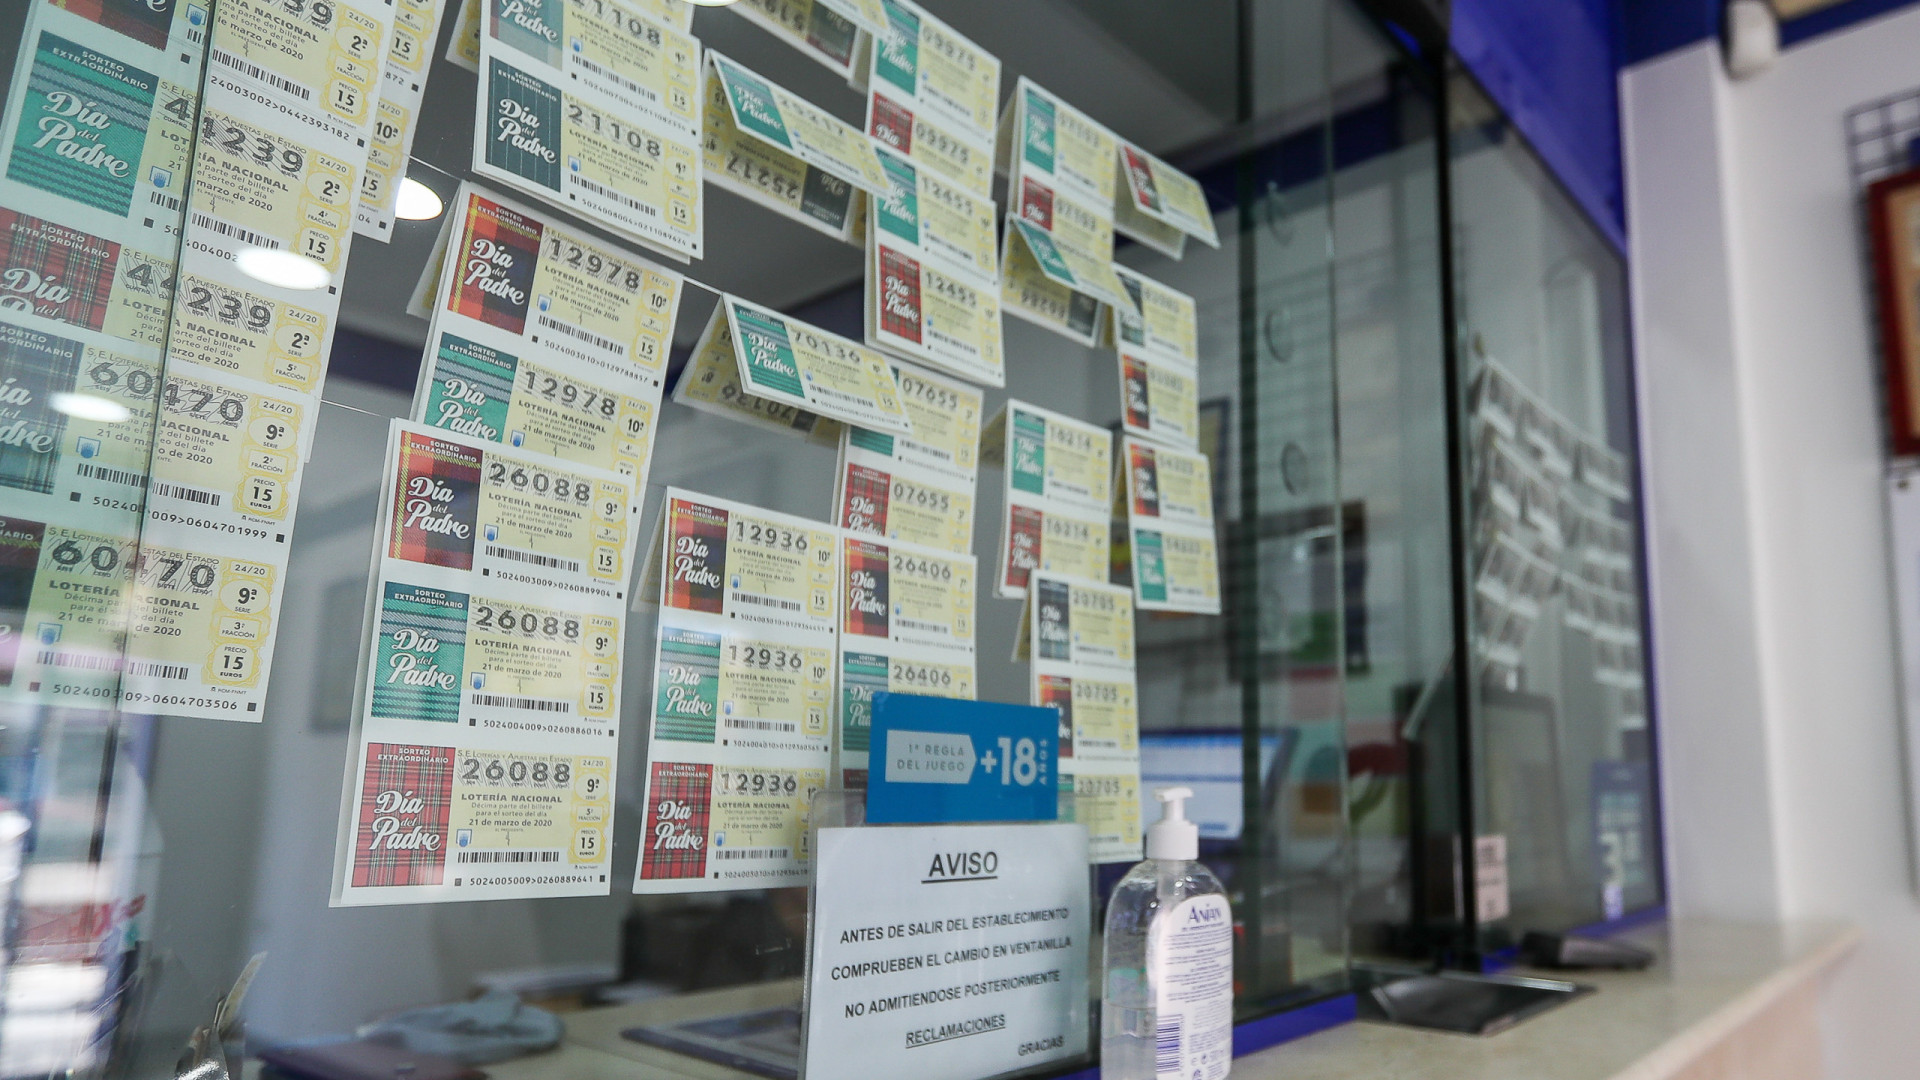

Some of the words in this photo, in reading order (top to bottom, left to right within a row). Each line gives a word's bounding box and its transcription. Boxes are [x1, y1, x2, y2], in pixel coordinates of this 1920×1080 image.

[254, 7, 319, 43] NACIONAL
[348, 11, 375, 30] 24/20
[280, 44, 304, 61] 2020
[394, 37, 411, 53] 15
[52, 47, 148, 90] EXTRAORDINARIO
[82, 50, 125, 72] SORTEO
[336, 89, 355, 106] 15
[42, 91, 110, 130] Día
[498, 98, 540, 128] Día
[76, 128, 100, 142] del
[521, 127, 536, 137] del
[568, 103, 661, 157] 21108
[33, 116, 130, 178] Padre
[497, 117, 557, 163] Padre
[319, 156, 348, 173] 24/20
[221, 160, 289, 192] NACIONAL
[248, 197, 273, 212] 2020
[495, 206, 523, 222] SORTEO
[306, 215, 337, 230] FRACCIÓN
[477, 205, 538, 235] EXTRAORDINARIO
[10, 223, 110, 259] EXTRAORDINARIO
[40, 224, 85, 243] SORTEO
[308, 229, 331, 242] PRECIO
[307, 237, 326, 255] 15
[471, 238, 514, 268] Día
[305, 251, 326, 263] EUROS
[550, 237, 642, 291] 12978
[464, 259, 525, 305] Padre
[492, 268, 506, 279] del
[1, 268, 71, 304] Día
[544, 265, 585, 289] LOTERÍA
[586, 282, 631, 305] NACIONAL
[36, 304, 59, 318] del
[289, 309, 317, 323] 24/20
[186, 322, 256, 348] NACIONAL
[449, 344, 512, 370] EXTRAORDINARIO
[468, 343, 497, 358] SORTEO
[640, 341, 653, 355] 15
[214, 355, 240, 370] 2020
[275, 368, 306, 382] FRACCIÓN
[442, 378, 486, 406] Día
[525, 371, 617, 417] 12978
[262, 399, 293, 414] 24/20
[464, 405, 479, 416] del
[518, 399, 559, 418] LOTERÍA
[561, 410, 606, 433] NACIONAL
[435, 400, 497, 441] Padre
[410, 441, 477, 463] EXTRAORDINARIO
[430, 440, 460, 452] SORTEO
[186, 452, 213, 465] 2020
[250, 461, 283, 474] FRACCIÓN
[253, 477, 276, 487] PRECIO
[408, 476, 455, 503] Día
[488, 462, 592, 502] 26088
[253, 486, 272, 501] 15
[893, 482, 950, 511] 07655
[250, 502, 272, 510] EUROS
[432, 502, 448, 514] del
[488, 492, 531, 509] LOTERÍA
[535, 500, 582, 520] NACIONAL
[404, 499, 470, 539] Padre
[554, 527, 573, 538] 2020
[735, 521, 808, 551] 12936
[676, 536, 709, 557] Día
[234, 564, 266, 576] 24/20
[598, 554, 612, 567] 15
[693, 558, 705, 567] del
[893, 555, 951, 580] 26406
[674, 555, 721, 589] Padre
[49, 580, 121, 597] LOTERÍA
[414, 589, 446, 599] SORTEO
[234, 606, 251, 614] SERIE
[394, 593, 463, 609] EXTRAORDINARIO
[153, 625, 182, 637] 2020
[475, 606, 580, 638] 26088
[221, 629, 255, 639] FRACCIÓN
[392, 629, 440, 653] Día
[223, 645, 248, 654] PRECIO
[475, 638, 519, 652] LOTERÍA
[522, 643, 572, 657] NACIONAL
[222, 654, 243, 670] 15
[417, 655, 433, 666] del
[728, 645, 802, 670] 12936
[387, 652, 456, 690] Padre
[543, 670, 562, 679] 2020
[668, 665, 700, 686] Día
[589, 691, 604, 704] 15
[665, 685, 712, 717] Padre
[685, 687, 697, 696] del
[377, 754, 449, 764] EXTRAORDINARIO
[398, 748, 431, 756] SORTEO
[924, 744, 965, 756] REGLA
[462, 758, 571, 783] 26088
[896, 759, 920, 771] DEL
[924, 760, 966, 772] JUEGO
[980, 736, 1038, 787] +18
[721, 773, 797, 792] 12936
[374, 790, 425, 815] Día
[461, 793, 507, 803] LOTERÍA
[511, 794, 563, 803] NACIONAL
[656, 800, 692, 820] Día
[400, 816, 417, 827] del
[519, 819, 532, 827] de
[533, 819, 553, 827] 2020
[674, 822, 687, 831] del
[369, 816, 442, 851] Padre
[580, 837, 595, 849] 15
[653, 821, 703, 850] Padre
[928, 851, 998, 878] AVISO
[840, 926, 884, 945] ANTES
[887, 924, 905, 939] DE
[907, 920, 943, 936] SALIR
[946, 918, 969, 932] DEL
[972, 907, 1069, 928] ESTABLECIMIENTO
[831, 956, 923, 981] COMPRUEBEN
[926, 953, 941, 967] EL
[944, 946, 990, 965] CAMBIO
[992, 943, 1008, 958] EN
[1010, 936, 1072, 955] VENTANILLA
[844, 1001, 865, 1019] NO
[868, 987, 961, 1015] ADMITIENDOSE
[964, 970, 1060, 997] POSTERIORMENTE
[905, 1013, 1006, 1046] RECLAMACIONES
[1017, 1035, 1065, 1057] GRACIAS
